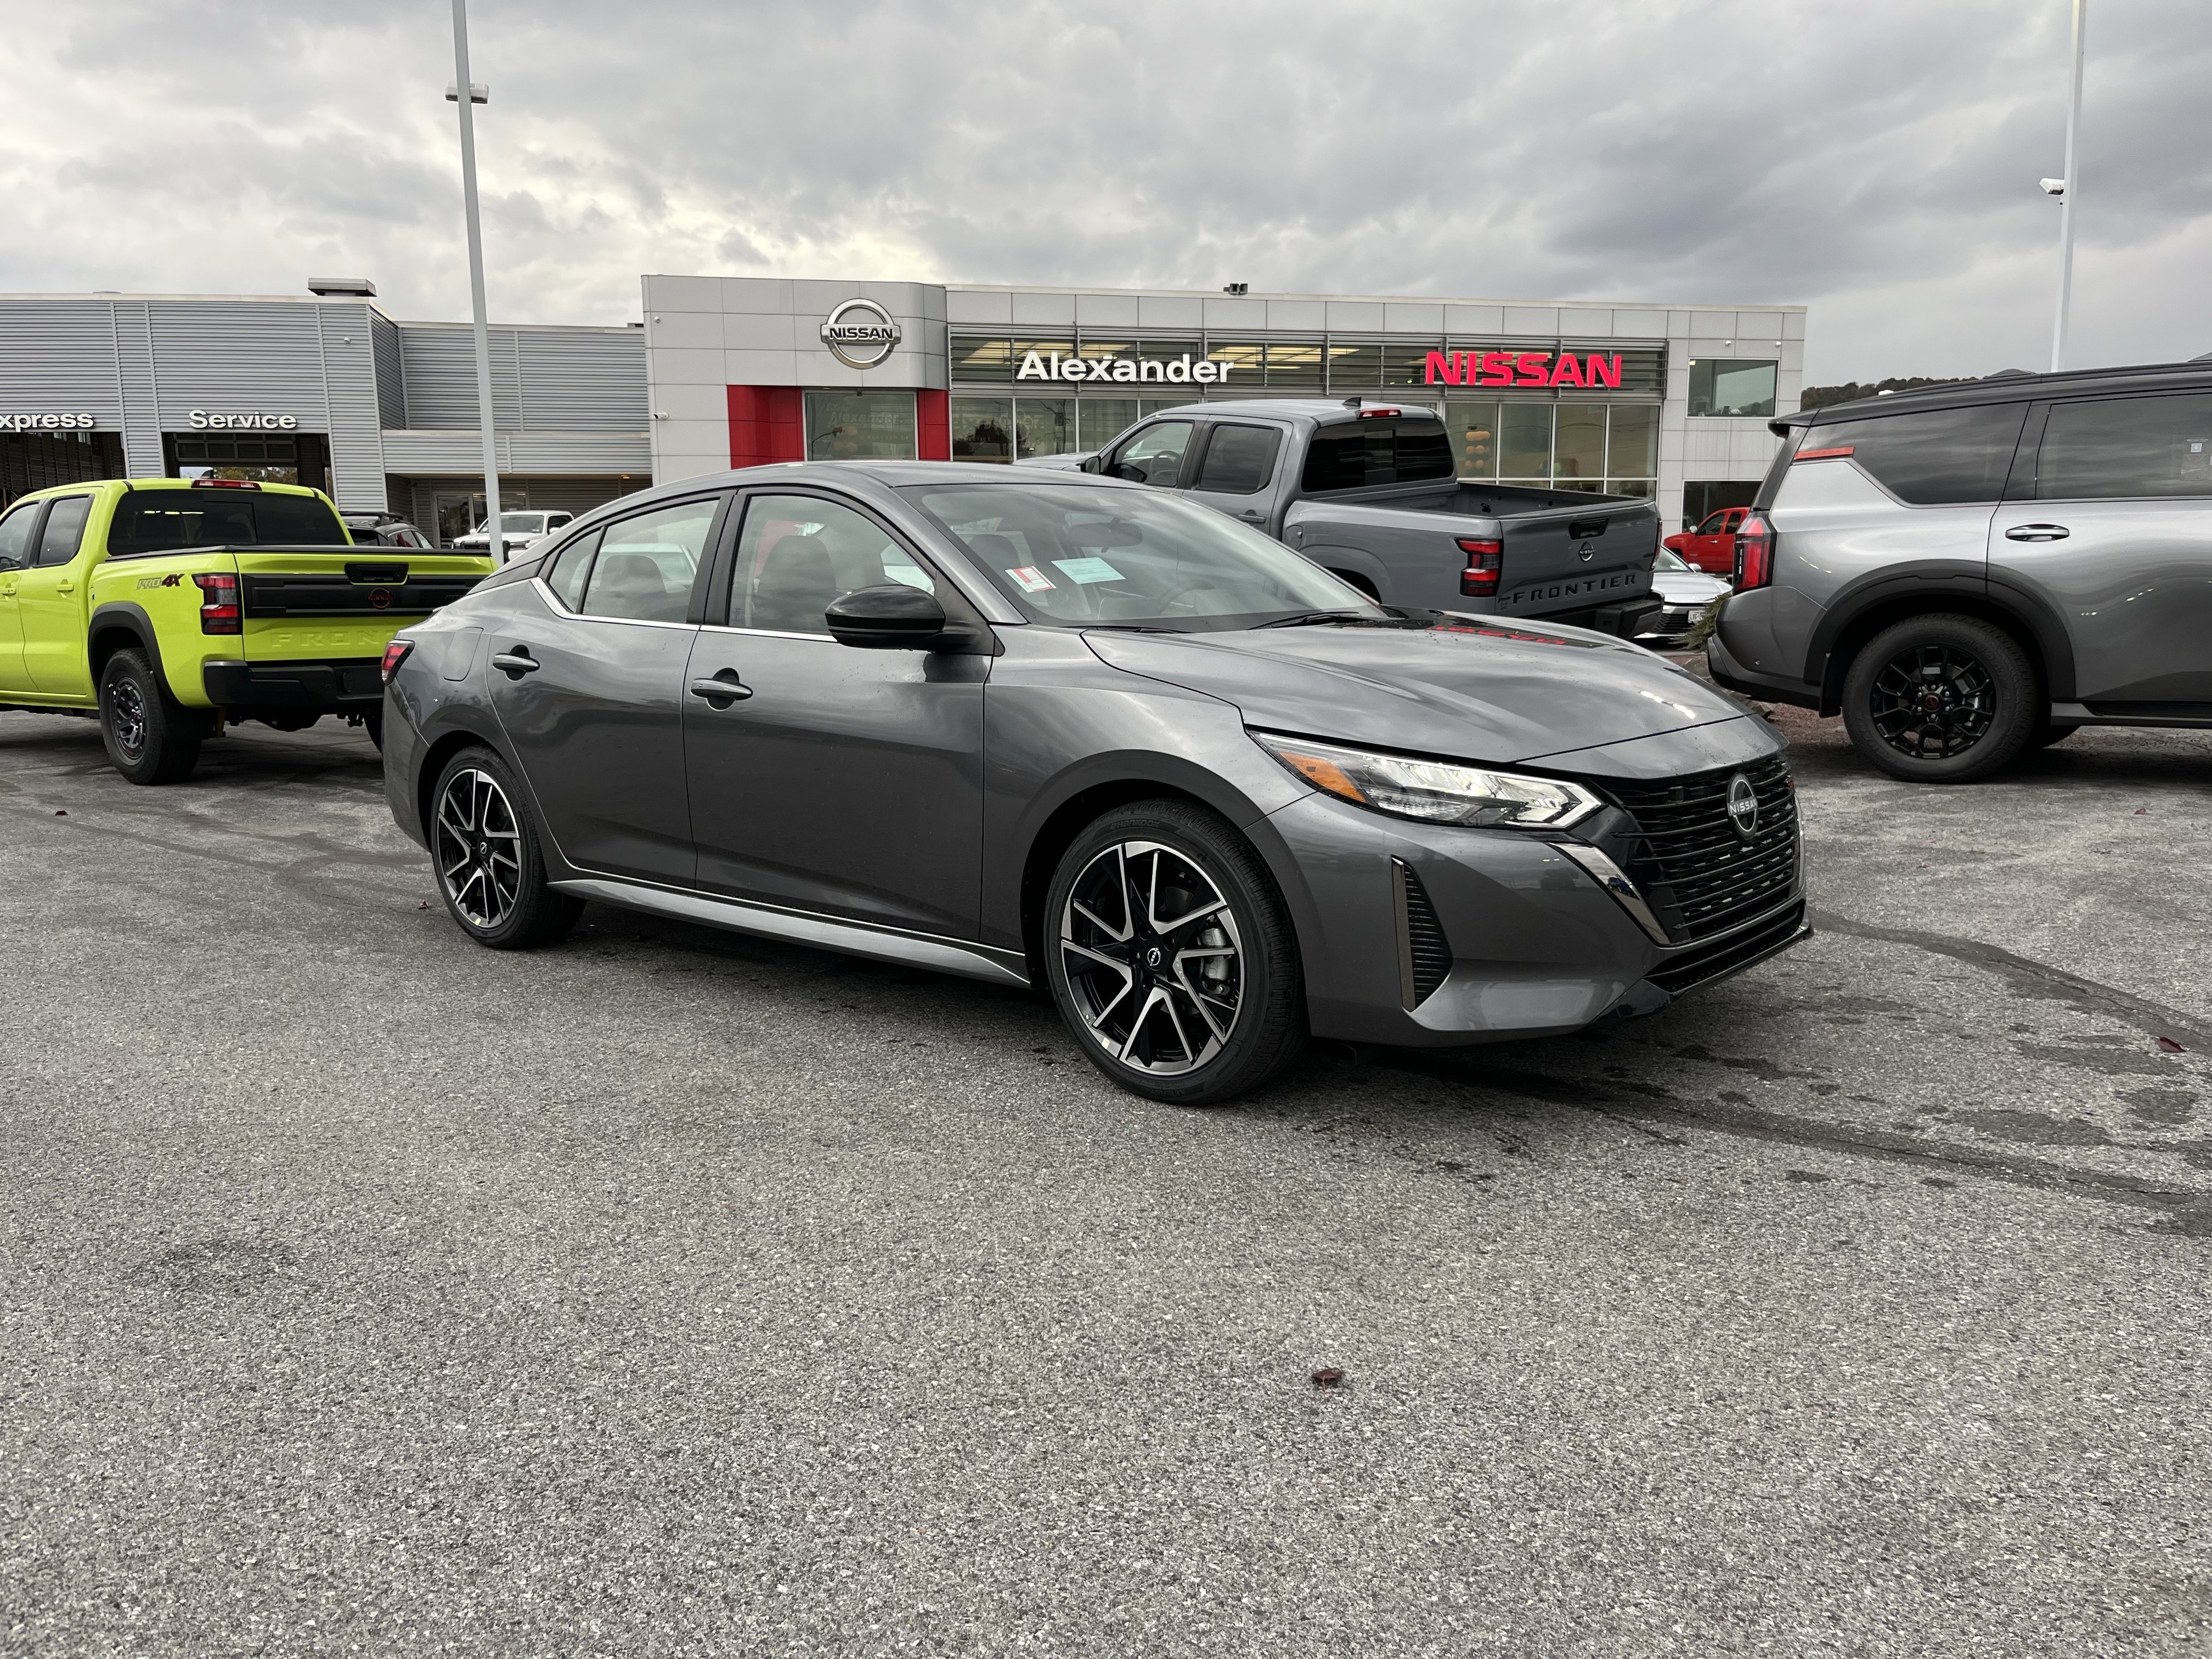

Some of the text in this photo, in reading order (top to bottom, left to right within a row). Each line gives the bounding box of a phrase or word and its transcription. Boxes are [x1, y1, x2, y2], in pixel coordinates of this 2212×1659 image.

[829, 327, 894, 340] NISSAN
[1016, 351, 1235, 383] Alexander
[1425, 351, 1622, 388] NISSAN
[188, 409, 297, 429] Service
[1513, 574, 1636, 604] FRONTIER
[1729, 798, 1757, 814] NISSAN
